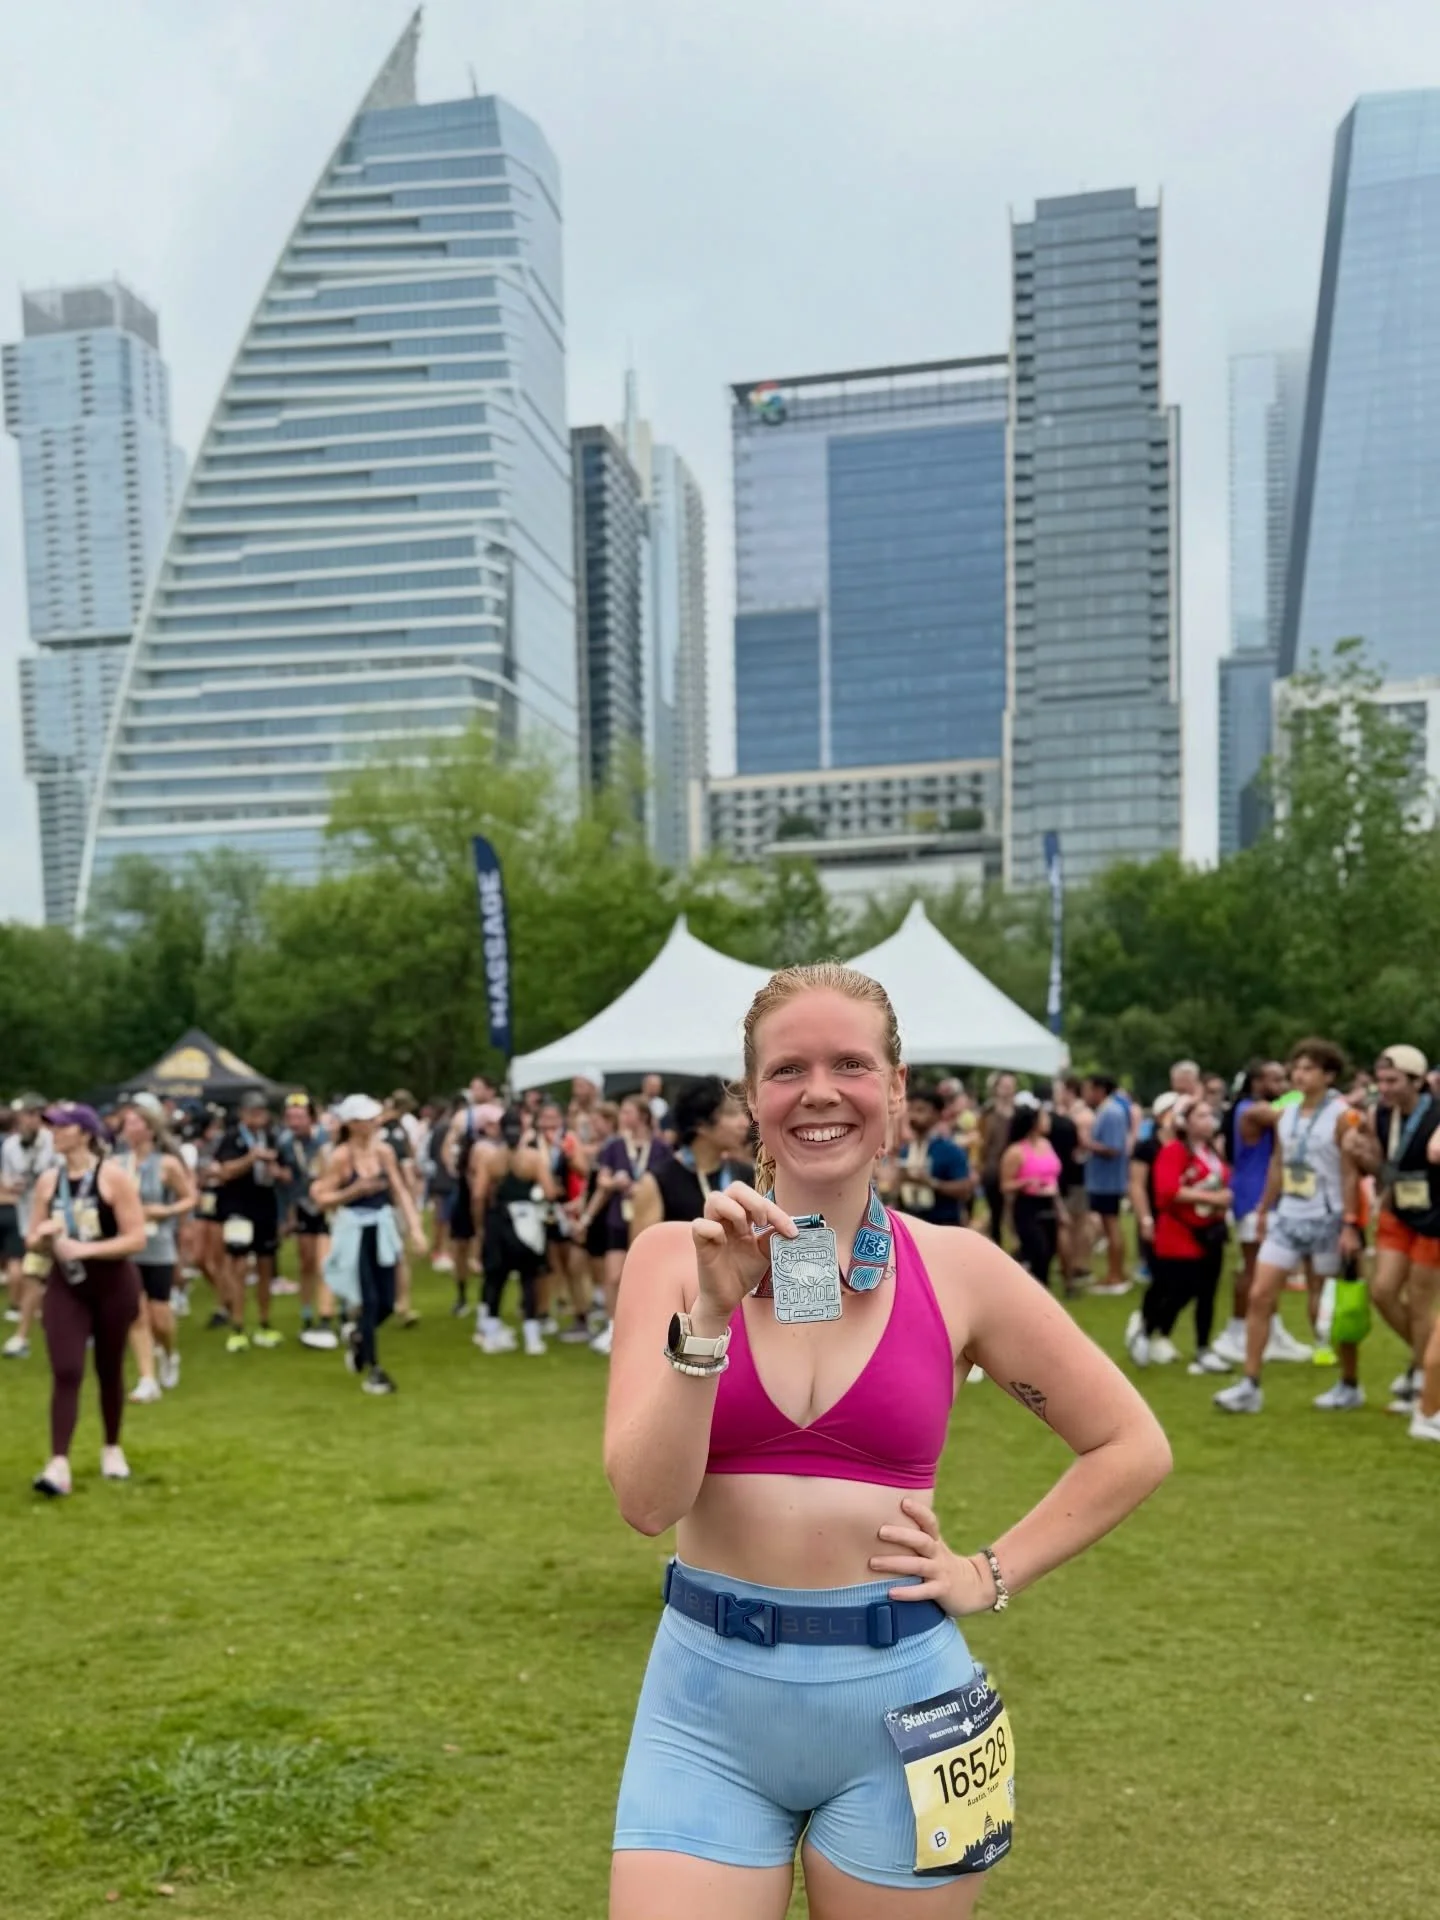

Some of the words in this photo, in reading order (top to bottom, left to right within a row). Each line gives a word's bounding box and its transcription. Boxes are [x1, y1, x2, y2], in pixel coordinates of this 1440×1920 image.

[866, 1236, 878, 1256] CAP
[876, 1238, 889, 1257] 10K
[903, 1700, 961, 1733] Statesman
[933, 1726, 1007, 1804] 16528
[934, 1832, 947, 1848] B
